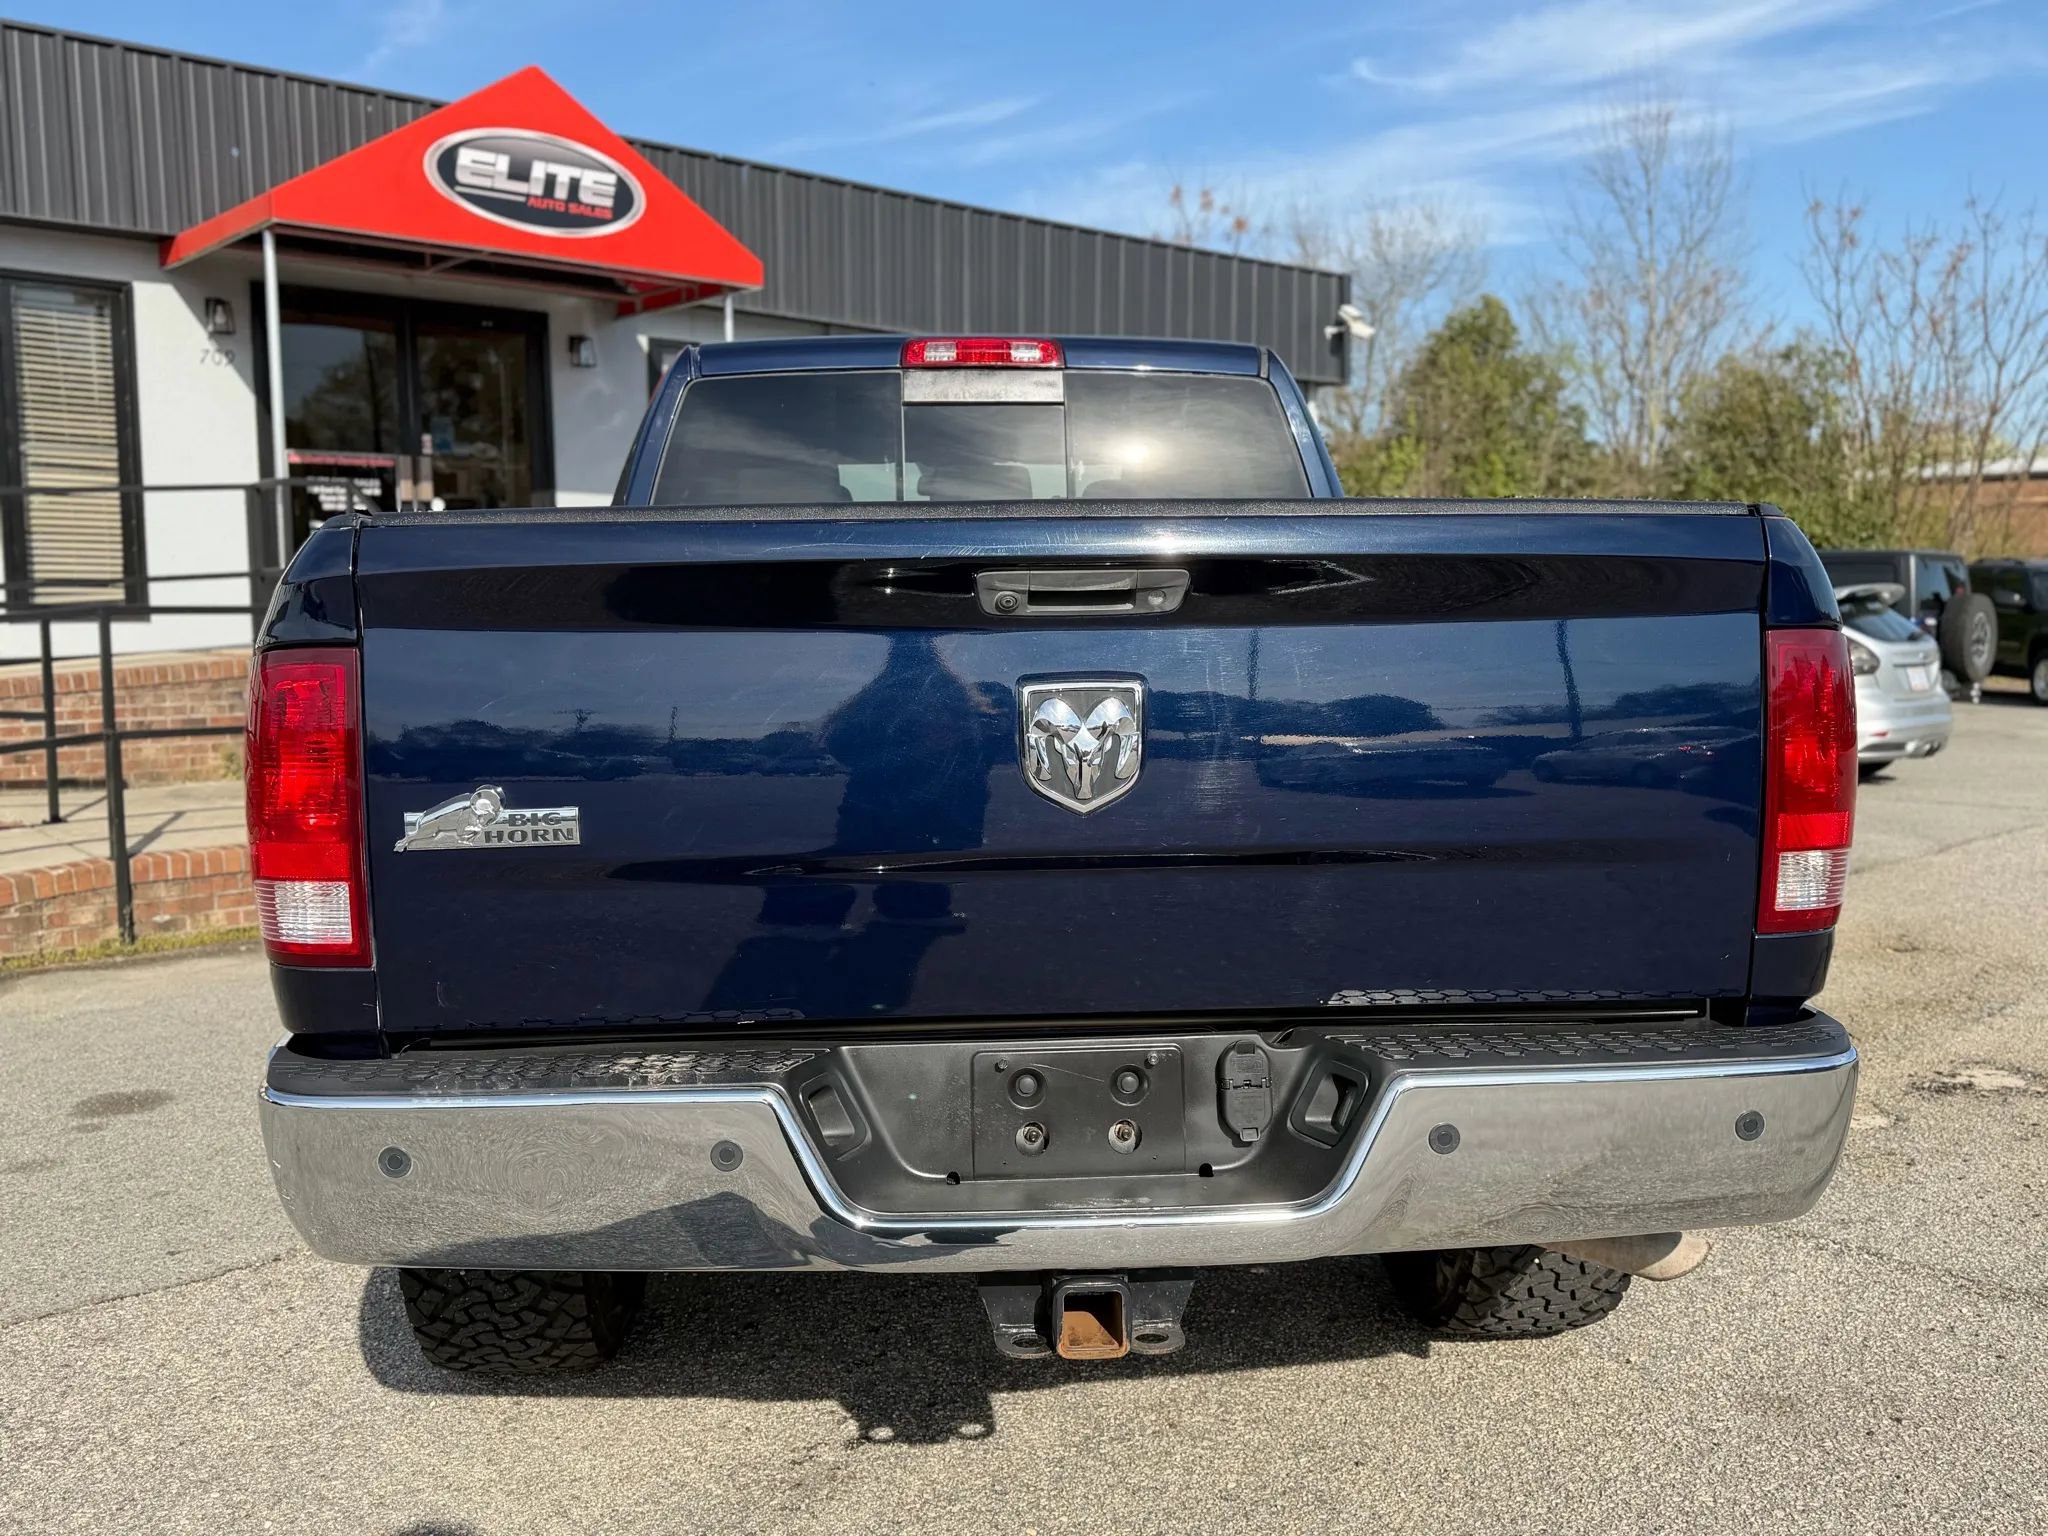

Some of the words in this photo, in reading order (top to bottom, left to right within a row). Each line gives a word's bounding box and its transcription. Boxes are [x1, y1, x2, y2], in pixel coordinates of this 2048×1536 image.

[455, 147, 618, 208] ELITE
[527, 196, 566, 213] AUTO
[568, 202, 613, 220] SALES
[508, 812, 562, 827] BIG
[484, 828, 574, 844] HORN
